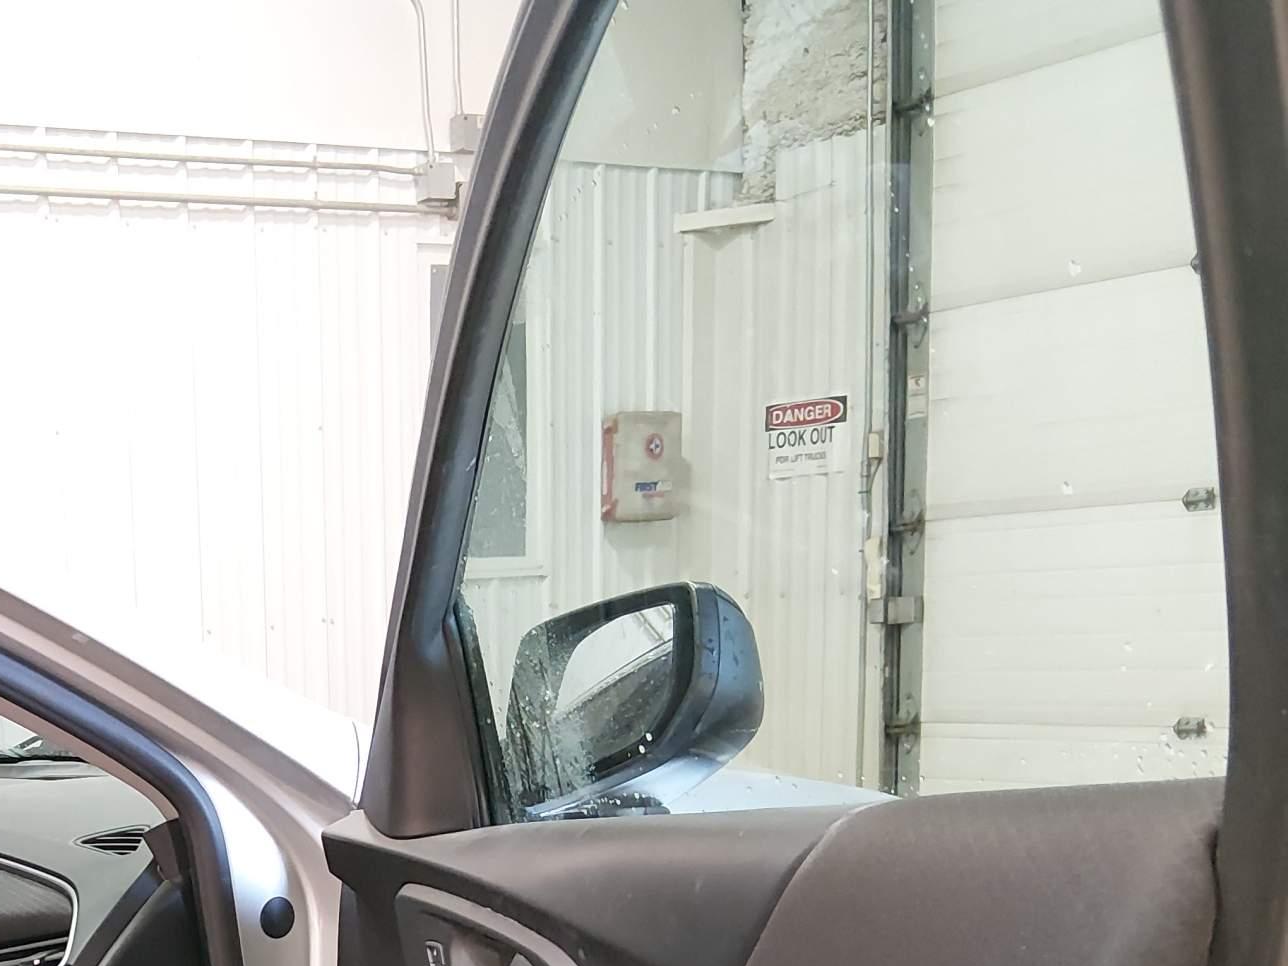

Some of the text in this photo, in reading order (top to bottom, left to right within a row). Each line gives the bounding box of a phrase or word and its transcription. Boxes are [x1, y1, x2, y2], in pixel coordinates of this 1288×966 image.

[772, 404, 832, 424] DANGER
[768, 426, 835, 449] LOOK OUT
[634, 481, 658, 492] FIRST
